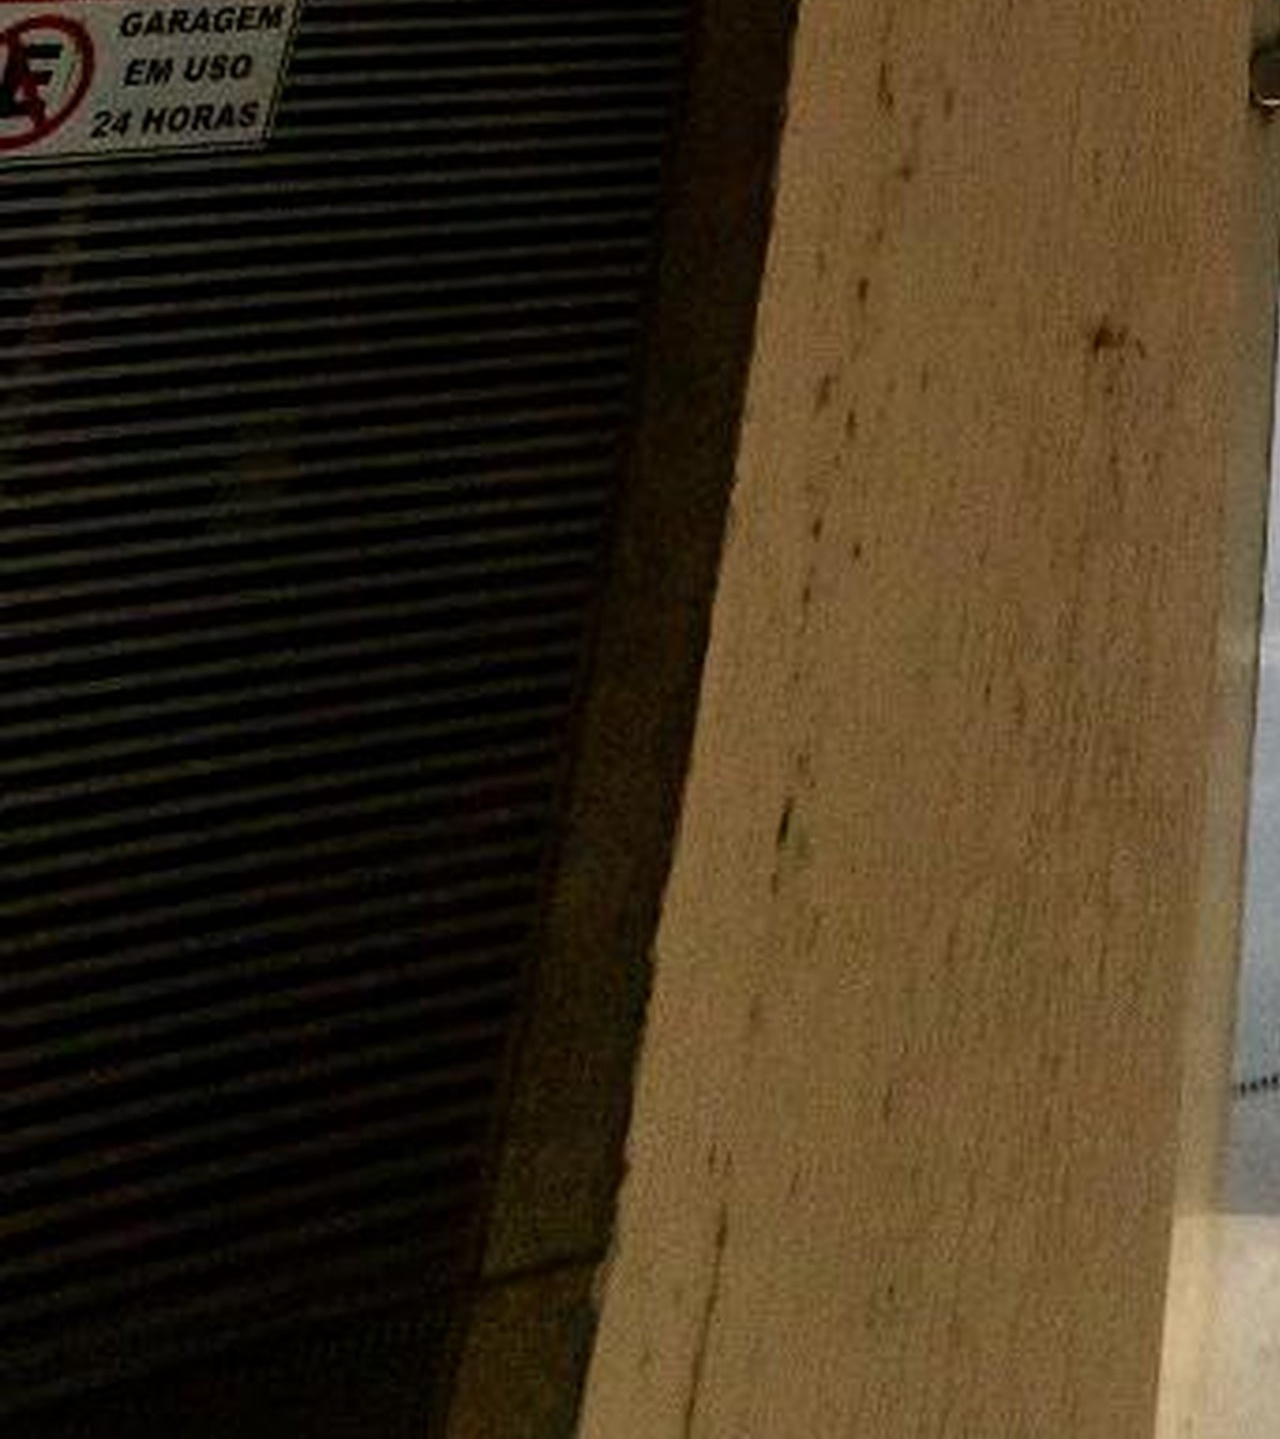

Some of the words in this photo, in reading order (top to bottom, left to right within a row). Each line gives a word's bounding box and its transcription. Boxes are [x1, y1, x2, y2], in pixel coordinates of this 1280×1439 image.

[120, 6, 283, 37] GARAGEM
[123, 58, 173, 86] EM
[183, 54, 253, 82] USO
[90, 110, 132, 139] 24
[141, 102, 259, 133] HORAS
